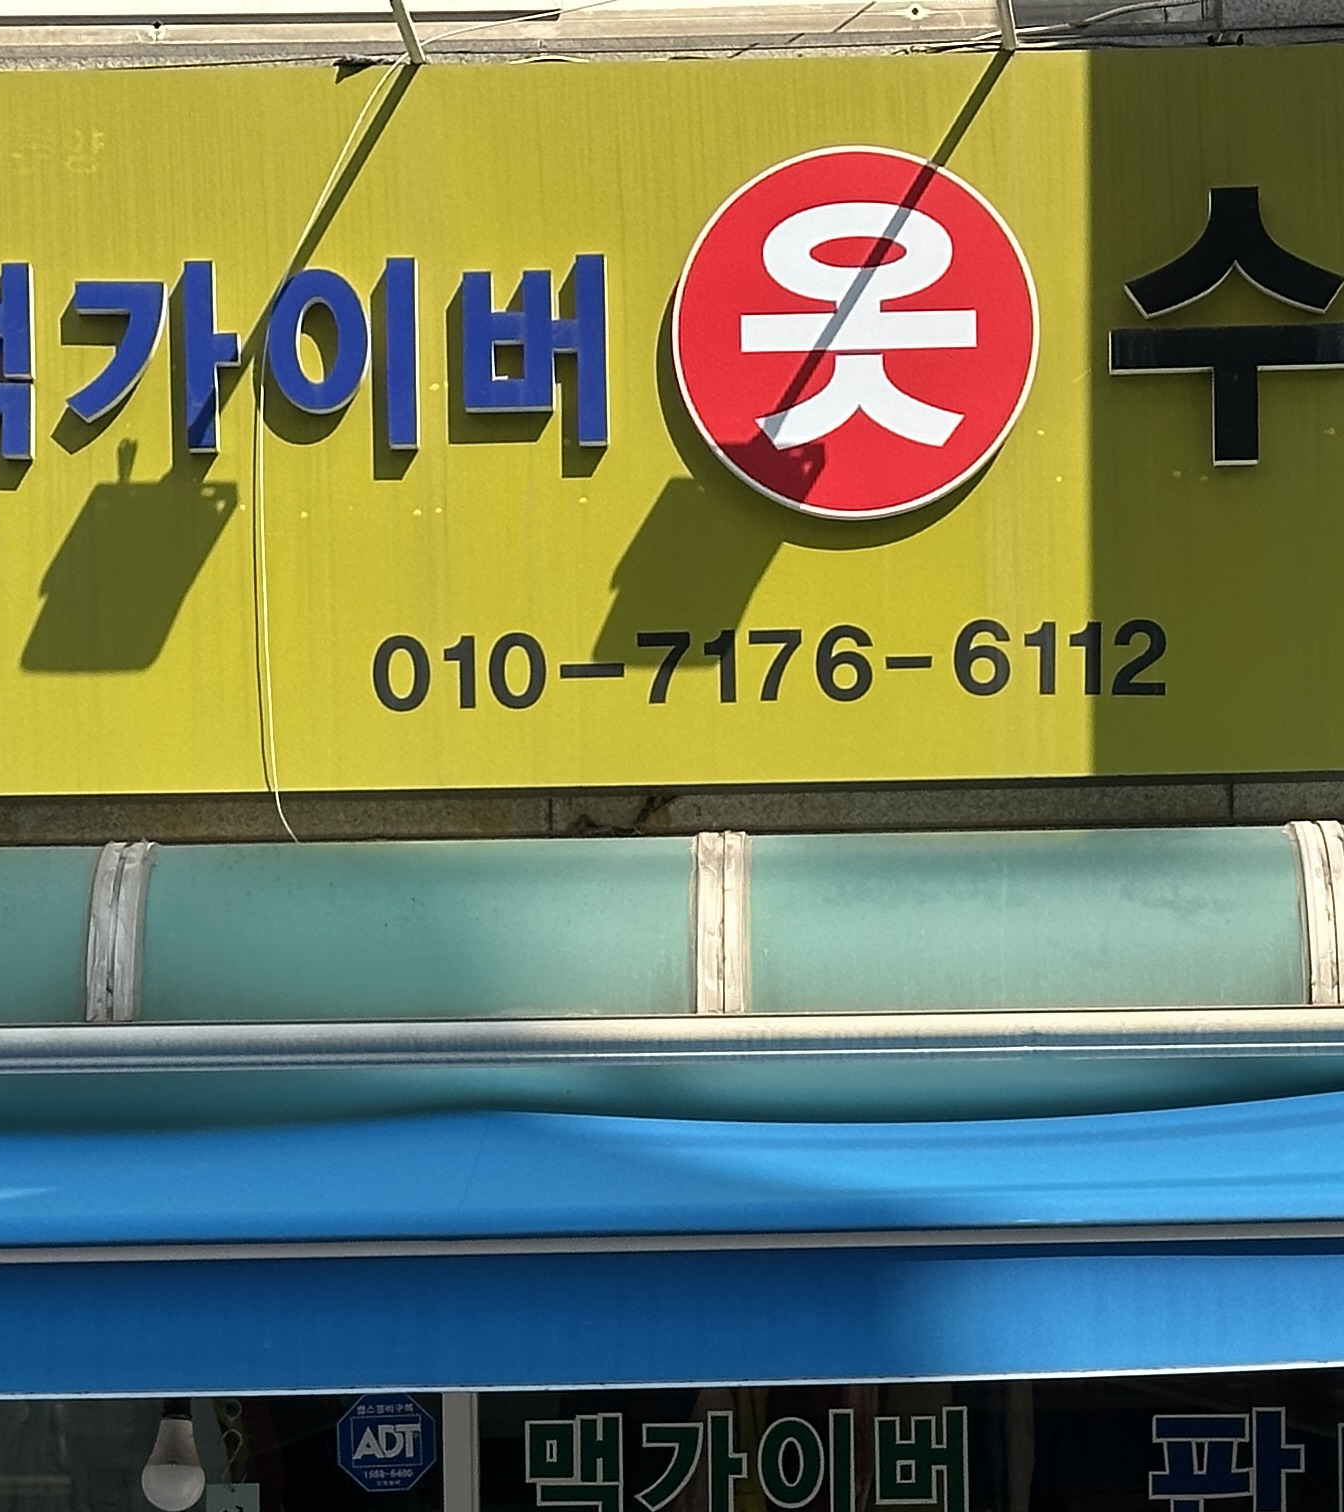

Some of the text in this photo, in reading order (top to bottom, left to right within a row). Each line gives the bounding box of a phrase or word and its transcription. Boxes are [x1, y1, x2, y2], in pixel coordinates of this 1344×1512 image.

[740, 200, 977, 450] 옷
[372, 618, 1168, 712] 010-7176-6112
[352, 1422, 422, 1461] ADT
